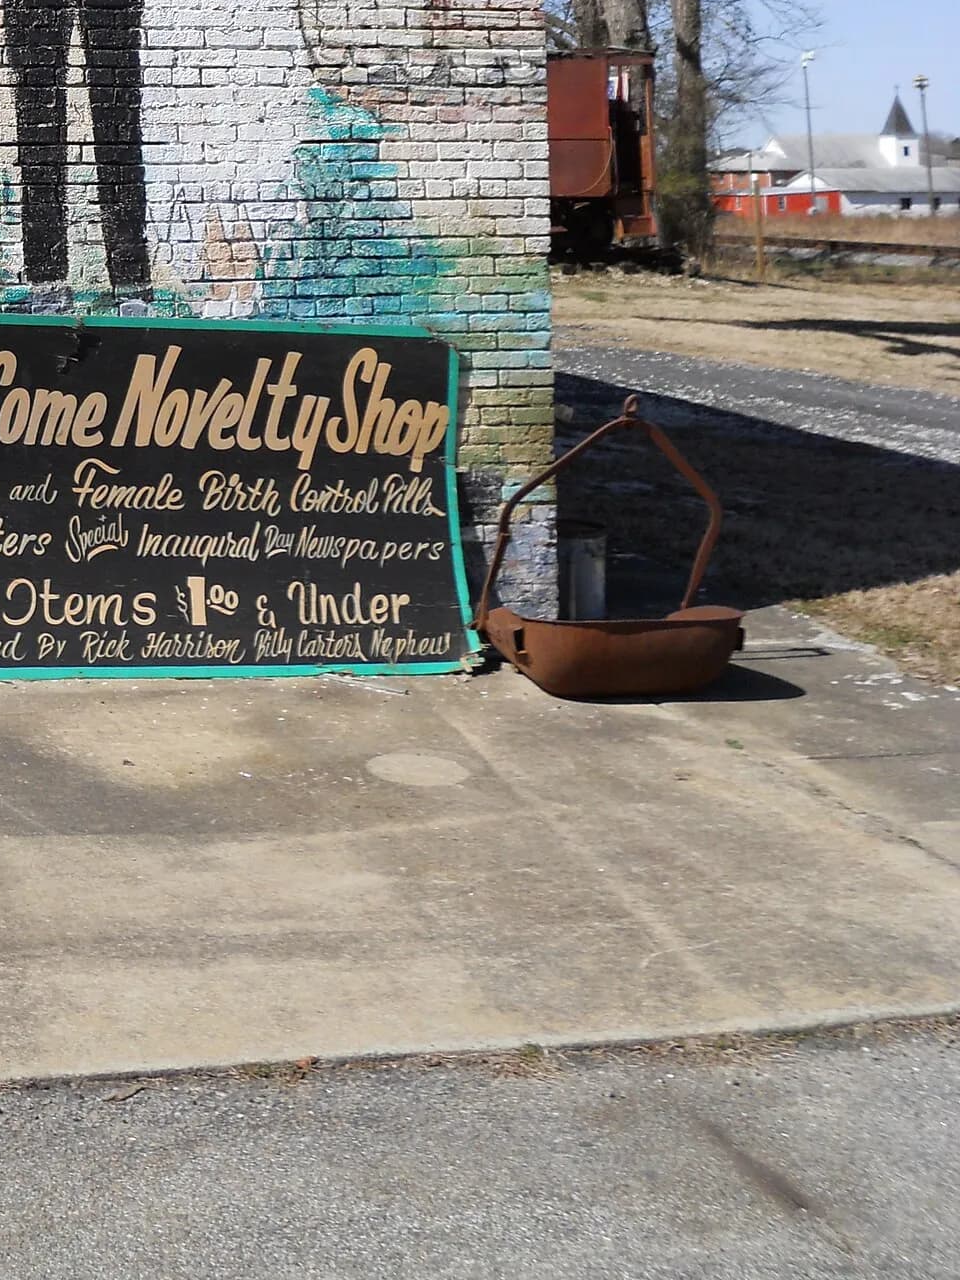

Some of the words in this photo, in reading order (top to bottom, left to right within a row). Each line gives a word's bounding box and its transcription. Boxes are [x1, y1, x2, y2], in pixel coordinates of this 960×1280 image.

[110, 345, 331, 470] Novelty
[326, 347, 451, 473] Shop
[10, 473, 58, 505] and
[72, 458, 185, 510] Female
[199, 470, 280, 516] Birth
[290, 473, 379, 515] Control
[381, 473, 446, 517] Pills
[65, 513, 129, 563] Special
[136, 520, 261, 568] Inaugural
[264, 524, 295, 558] Day
[294, 524, 445, 568] Newspapers
[2, 577, 157, 628] Items
[256, 594, 276, 628] &
[287, 580, 410, 626] Under
[38, 632, 66, 660] By
[79, 630, 134, 663] Rick
[141, 630, 246, 664] Harrison
[253, 627, 292, 664] Billy
[368, 628, 451, 664] Nephew
